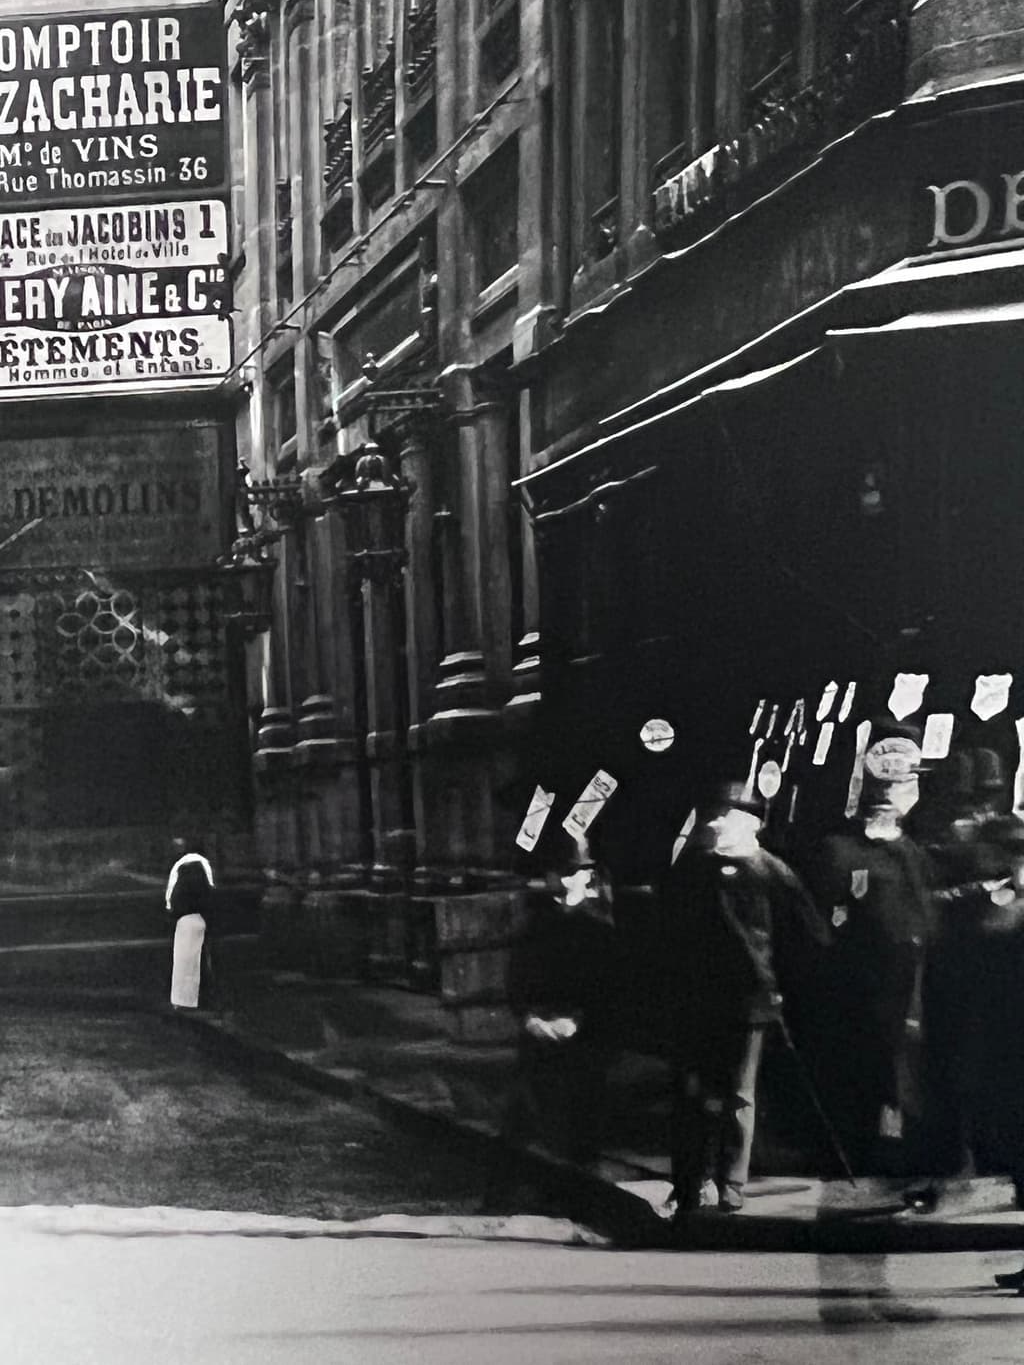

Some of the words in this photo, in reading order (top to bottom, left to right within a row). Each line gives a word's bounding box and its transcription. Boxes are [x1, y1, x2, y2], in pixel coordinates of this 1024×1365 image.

[40, 141, 61, 165] de
[72, 134, 159, 162] VINS
[46, 162, 166, 189] Thomassin
[179, 157, 208, 181] 36
[67, 208, 186, 246] JACOBINS
[199, 205, 216, 238] 1
[27, 251, 56, 266] Rue
[152, 242, 188, 258] Ville
[164, 284, 182, 311] &
[9, 365, 89, 382] Hommes
[103, 361, 121, 376] et
